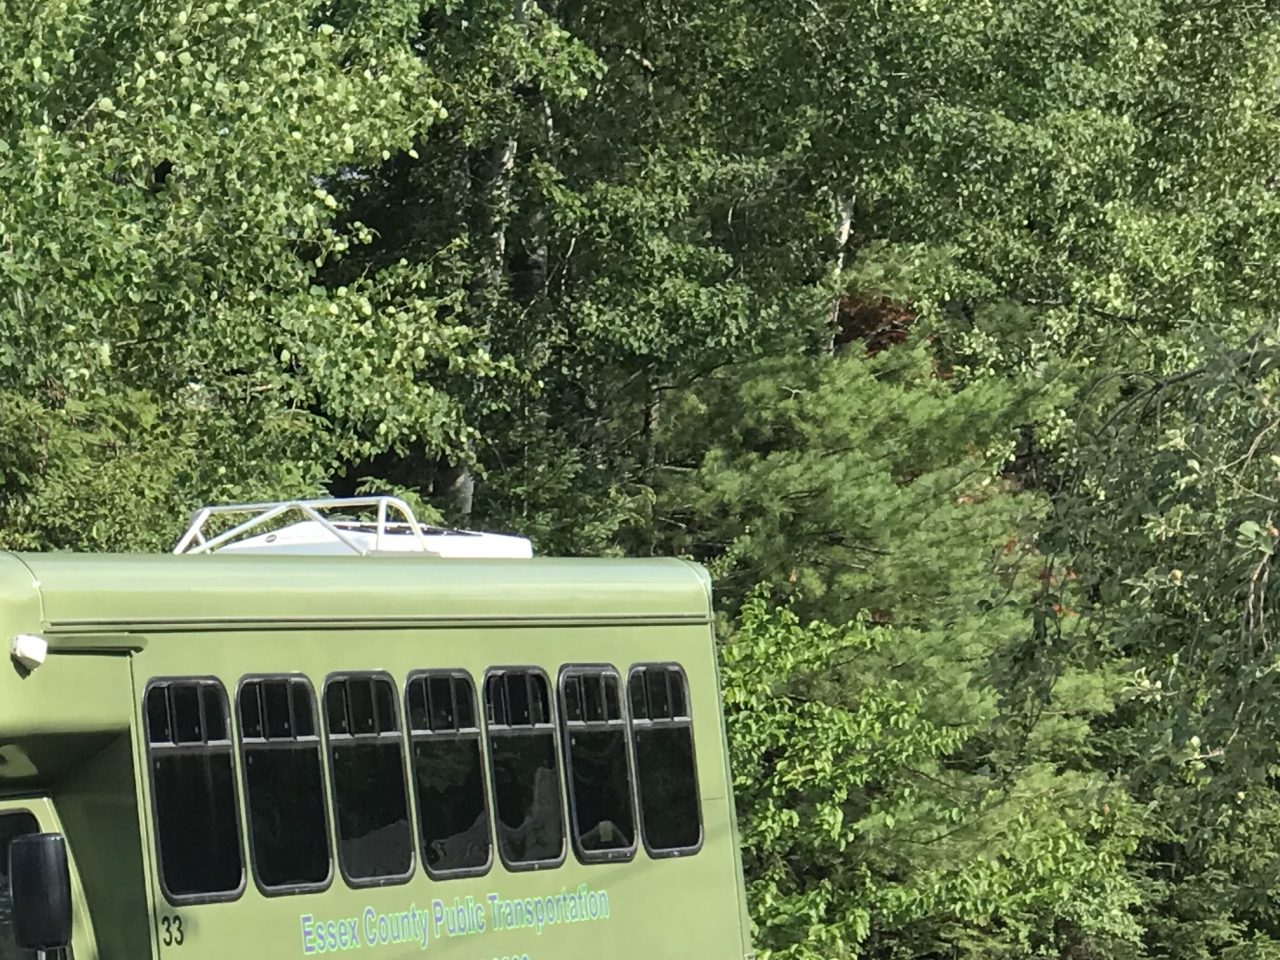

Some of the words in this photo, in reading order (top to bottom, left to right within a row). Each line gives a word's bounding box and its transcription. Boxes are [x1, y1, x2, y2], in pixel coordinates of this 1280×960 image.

[161, 914, 184, 947] 33
[300, 913, 361, 955] Essex
[363, 903, 429, 950] County
[431, 896, 487, 938] Public
[487, 883, 610, 935] Transportation
